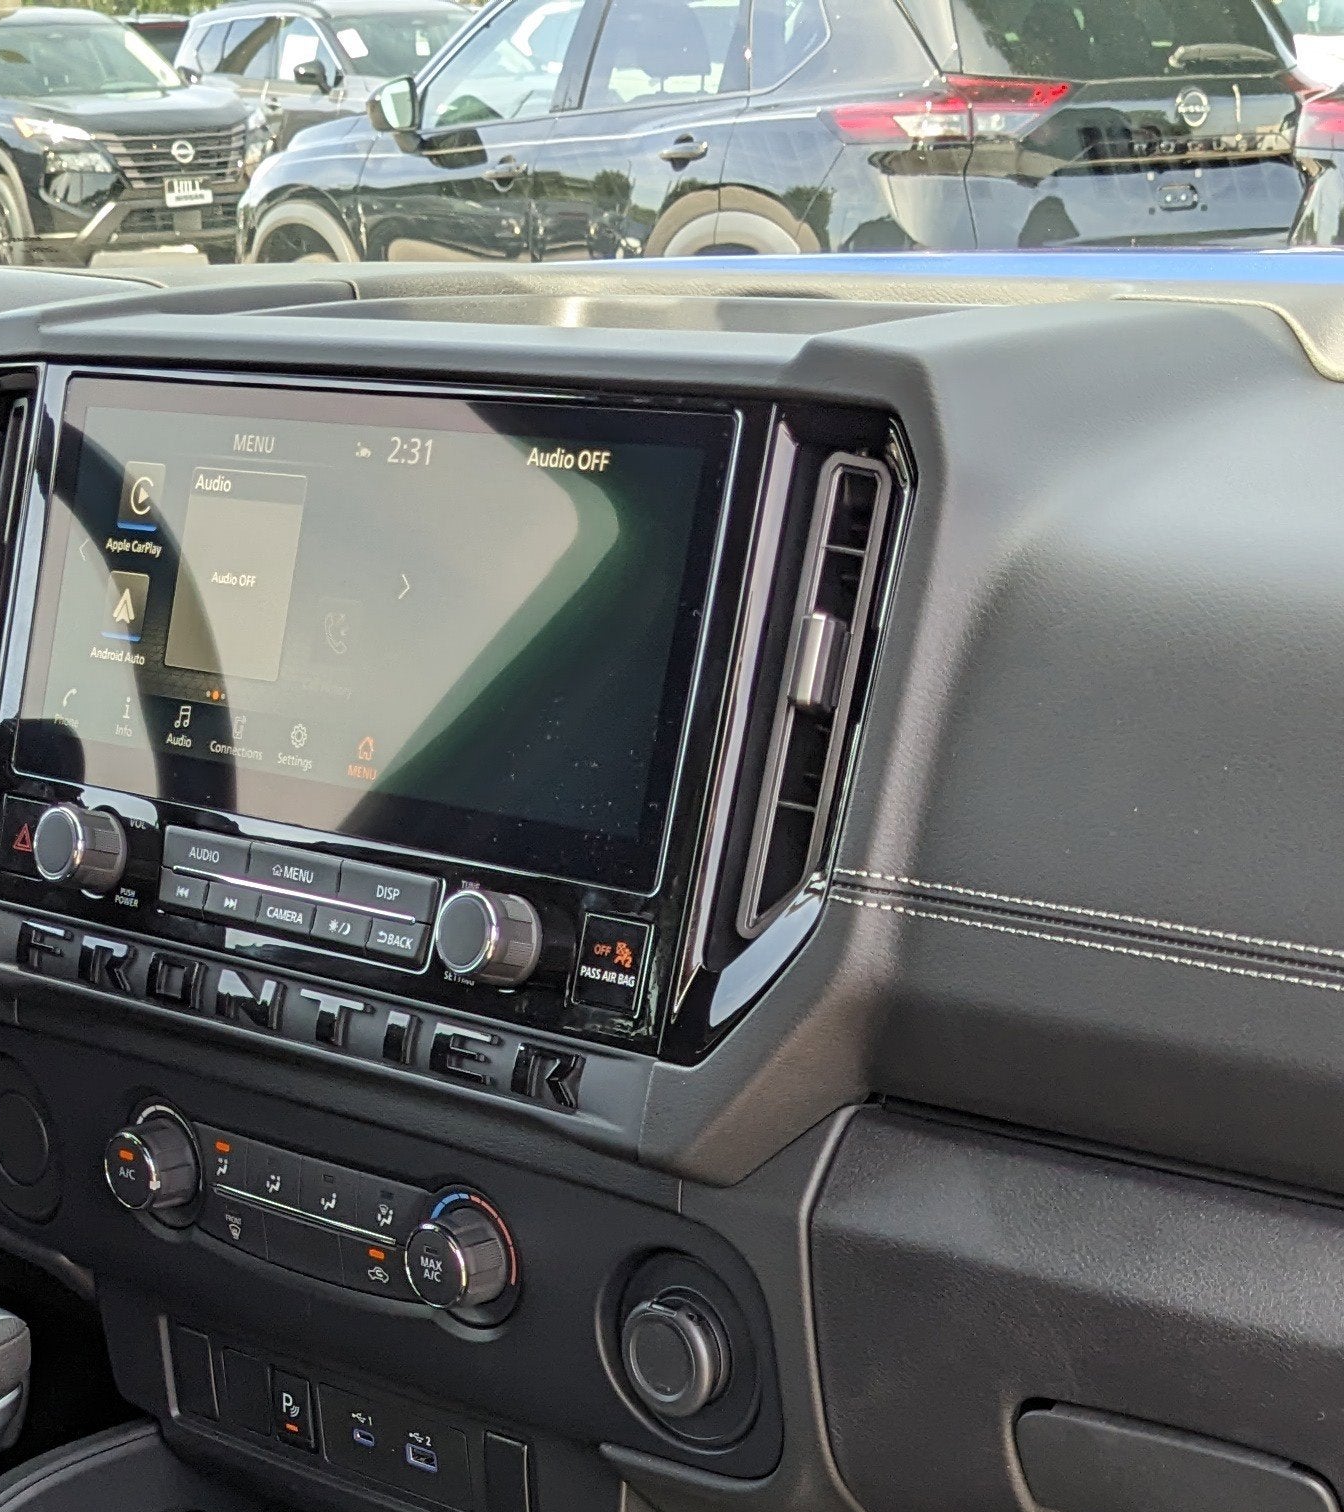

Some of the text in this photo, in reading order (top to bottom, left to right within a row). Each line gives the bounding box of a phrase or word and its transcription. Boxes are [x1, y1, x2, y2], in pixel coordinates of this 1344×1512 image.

[233, 433, 275, 454] MENU
[386, 436, 434, 466] 2:31
[526, 446, 611, 473] Audio OFF
[195, 474, 232, 493] Audio
[106, 537, 162, 558] Apple CarPlay
[211, 570, 257, 587] Audio OFF
[90, 646, 146, 666] Android Auto
[115, 723, 133, 738] Info
[166, 732, 192, 749] Audio
[210, 740, 264, 761] Connections
[277, 752, 313, 771] Settings
[347, 765, 378, 781] MENU
[188, 846, 220, 864] AUDIO
[283, 865, 314, 884] MENU
[376, 884, 401, 901] DISP
[266, 906, 304, 925] CAMERA
[386, 934, 414, 951] BACK
[593, 944, 612, 956] OFF
[579, 965, 636, 988] PASS AIR BAG
[16, 920, 586, 1114] FRONTIER
[118, 1166, 136, 1181] A/C
[225, 1213, 242, 1225] FRONT
[420, 1256, 443, 1272] MAX
[423, 1269, 441, 1283] A/C
[425, 1437, 432, 1447] 2
